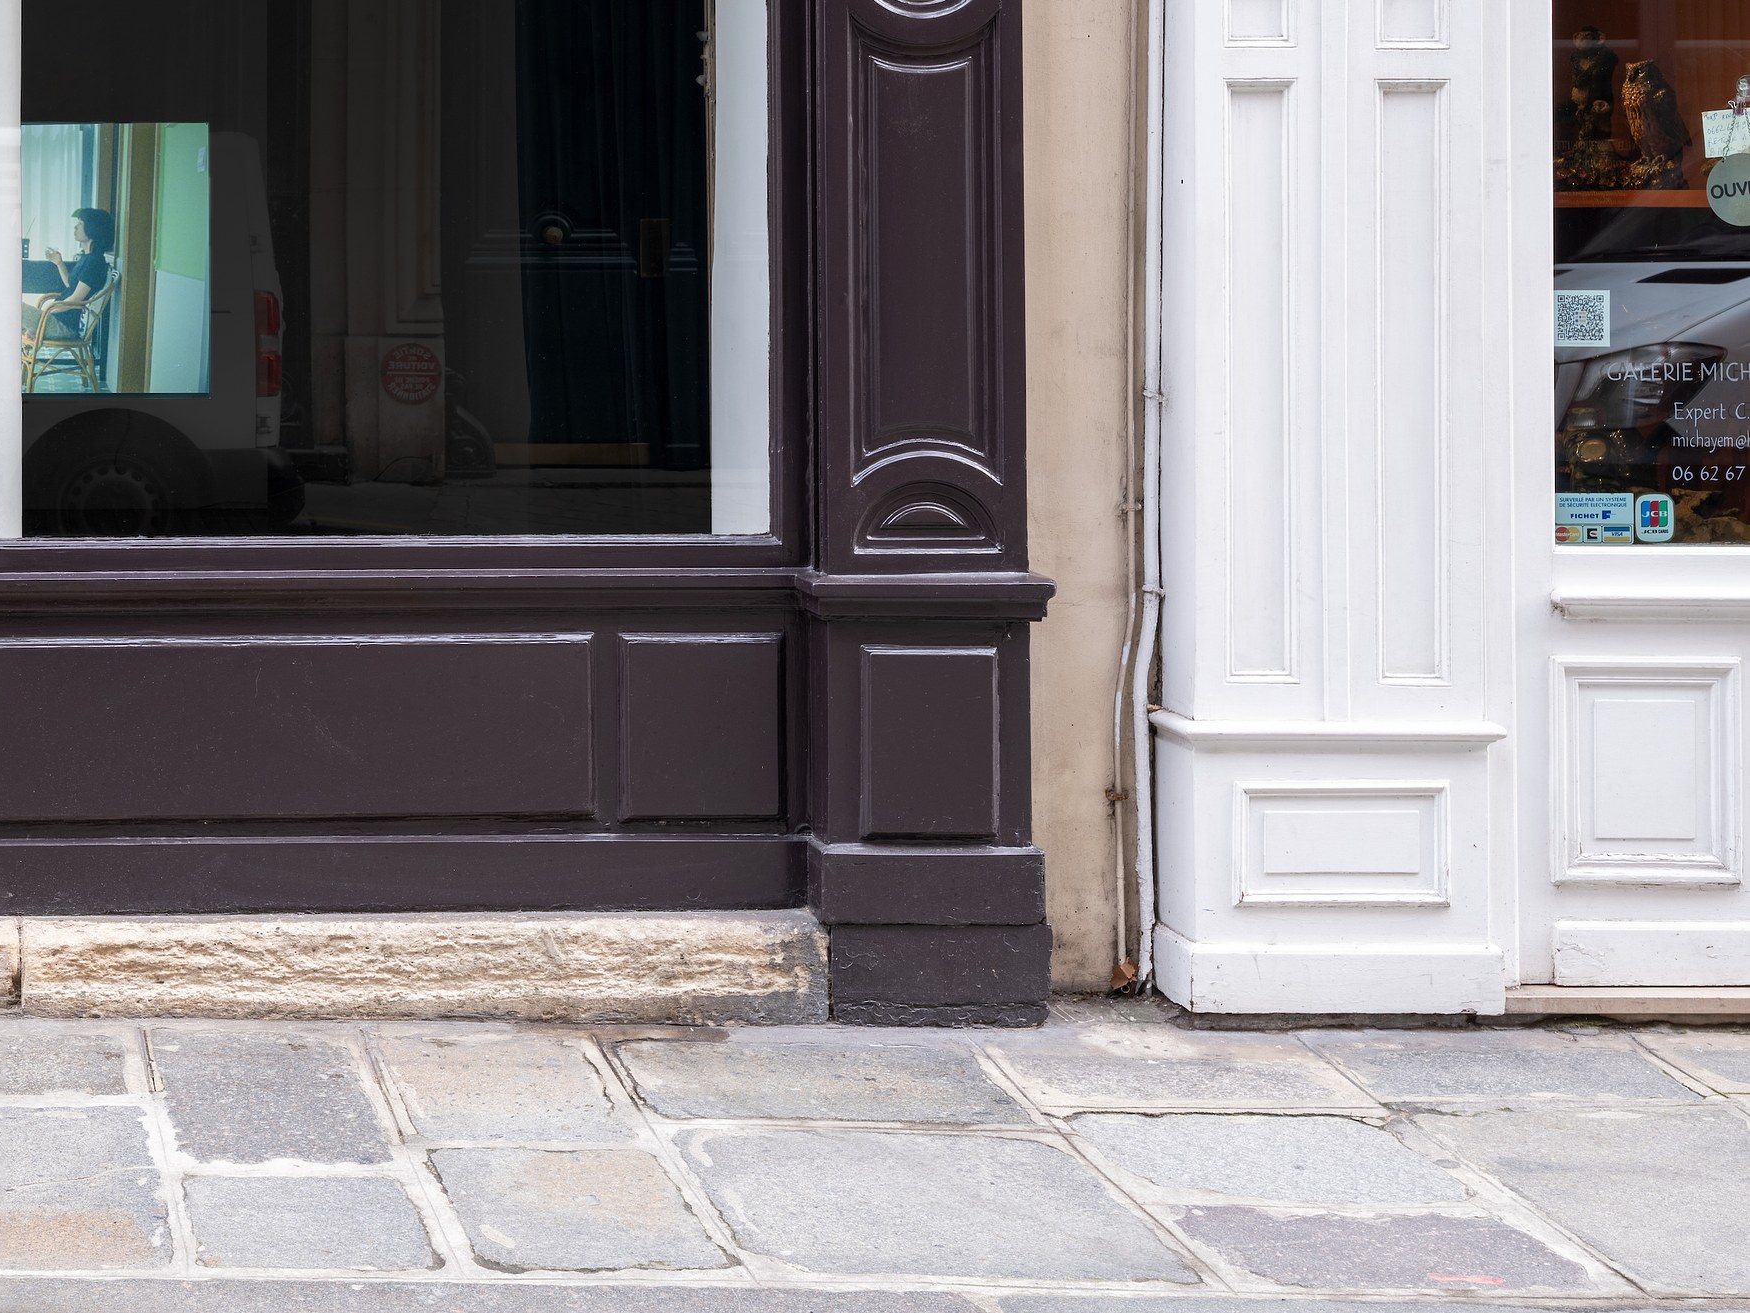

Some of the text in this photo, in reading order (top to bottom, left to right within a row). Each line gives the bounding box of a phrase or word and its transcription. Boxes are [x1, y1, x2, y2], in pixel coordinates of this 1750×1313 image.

[1711, 181, 1750, 199] OUV
[1607, 362, 1750, 381] GALERIE MICH
[1674, 402, 1750, 427] Expert C.
[1672, 465, 1746, 481] 06 62 67
